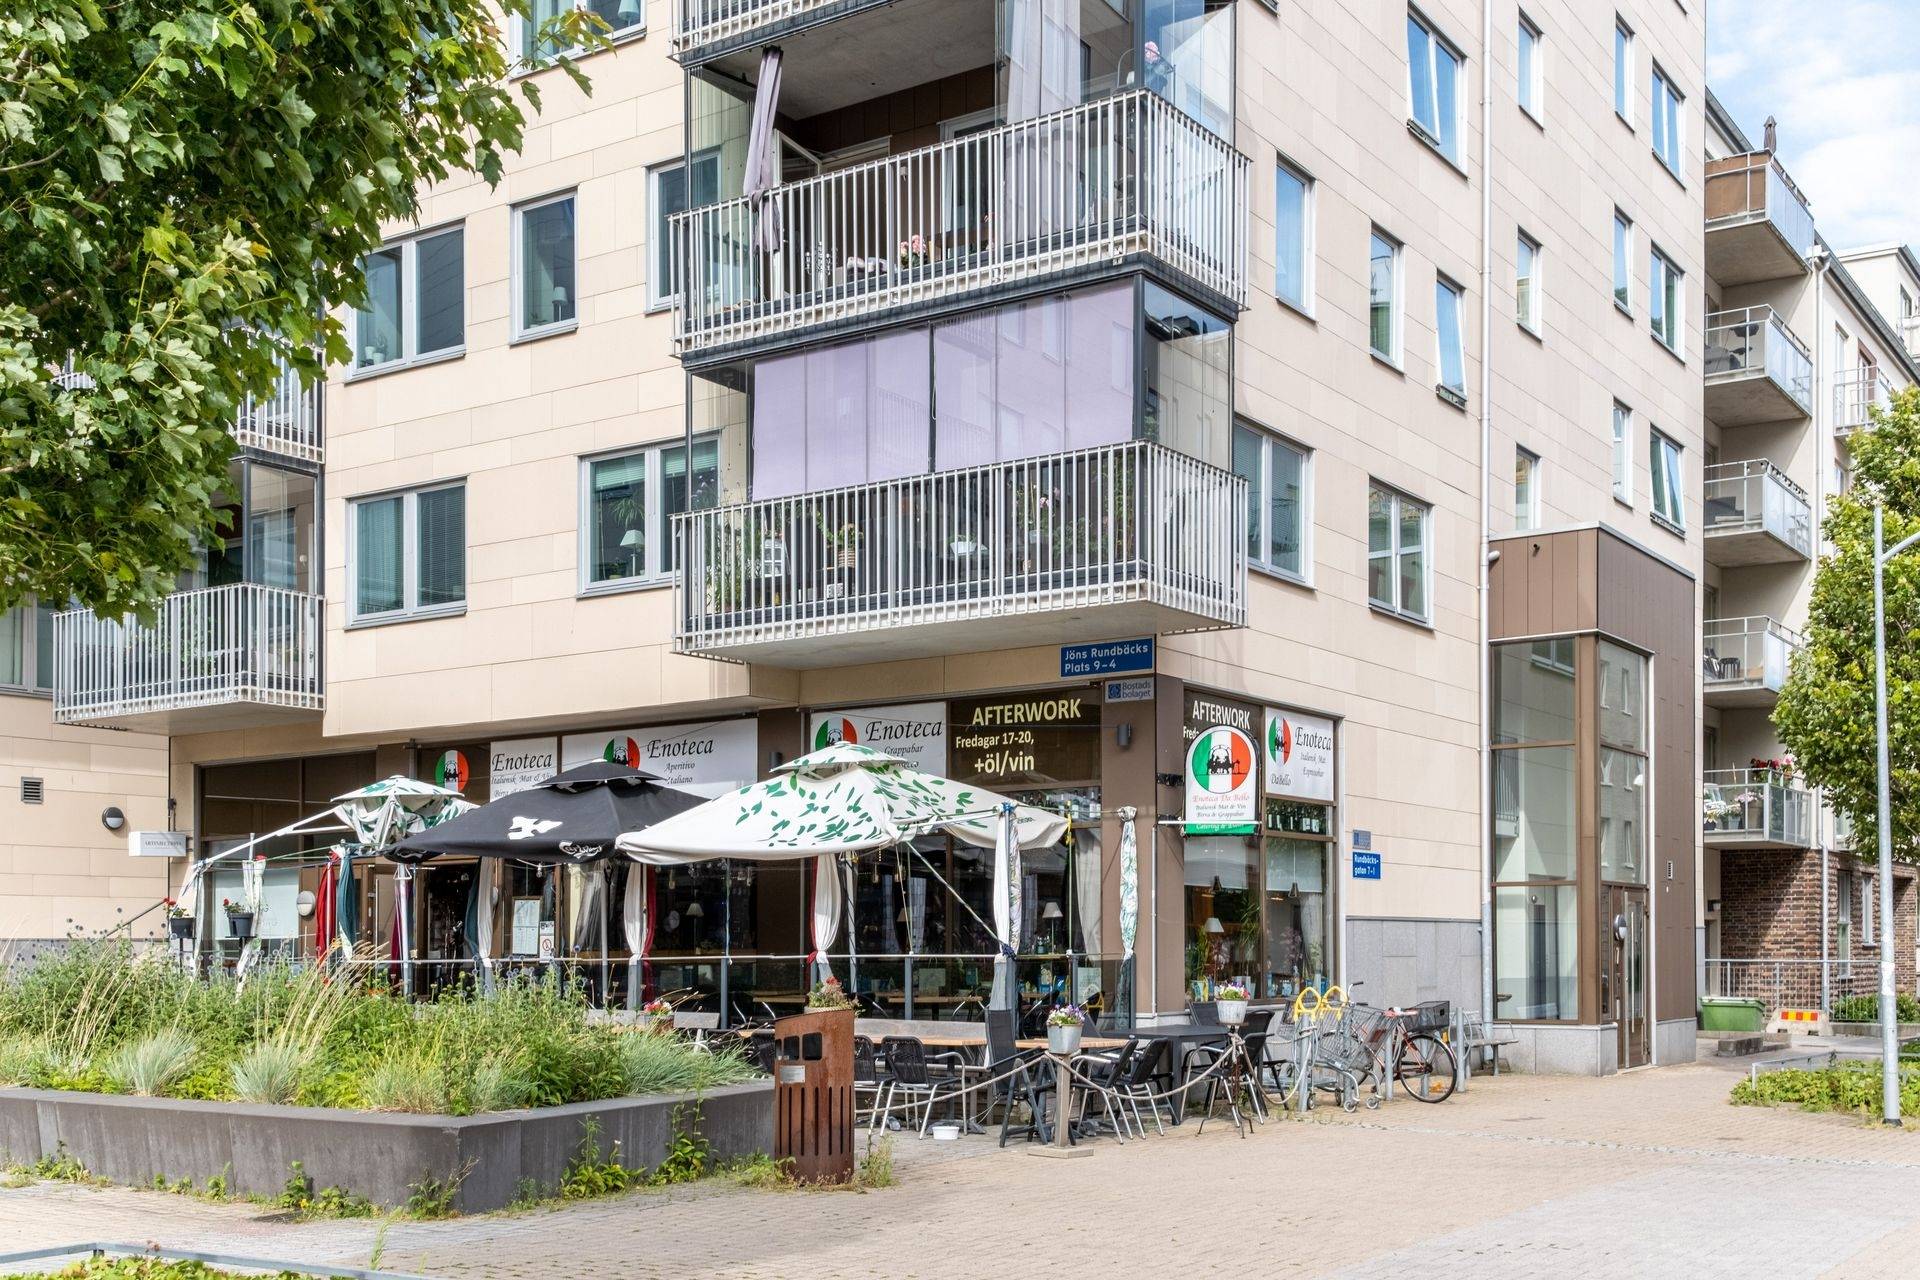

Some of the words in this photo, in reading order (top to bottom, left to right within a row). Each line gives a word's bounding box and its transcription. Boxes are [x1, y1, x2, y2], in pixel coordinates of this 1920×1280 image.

[1065, 650, 1088, 660] Jöns
[1091, 644, 1149, 658] Rundbäcks
[1065, 662, 1090, 673] Plats
[1122, 681, 1151, 691] Bostads
[1122, 689, 1151, 700] bolaget
[972, 699, 1081, 726] AFTERWORK
[1192, 700, 1250, 730] AFTERWORK
[866, 720, 943, 741] Enoteca
[1295, 727, 1332, 751] Enoteca
[956, 735, 1000, 749] Fredagar
[1003, 731, 1034, 745] 17-20,
[647, 739, 714, 759] Enoteca
[884, 743, 924, 757] Grappabar
[491, 753, 553, 771] Enoteca
[664, 761, 695, 773] Aperitivo
[974, 750, 1035, 777] +öl/vin
[1192, 795, 1219, 803] Enoteca
[1221, 794, 1232, 802] Da
[1234, 792, 1250, 802] Bello
[1354, 866, 1367, 876] gatan
